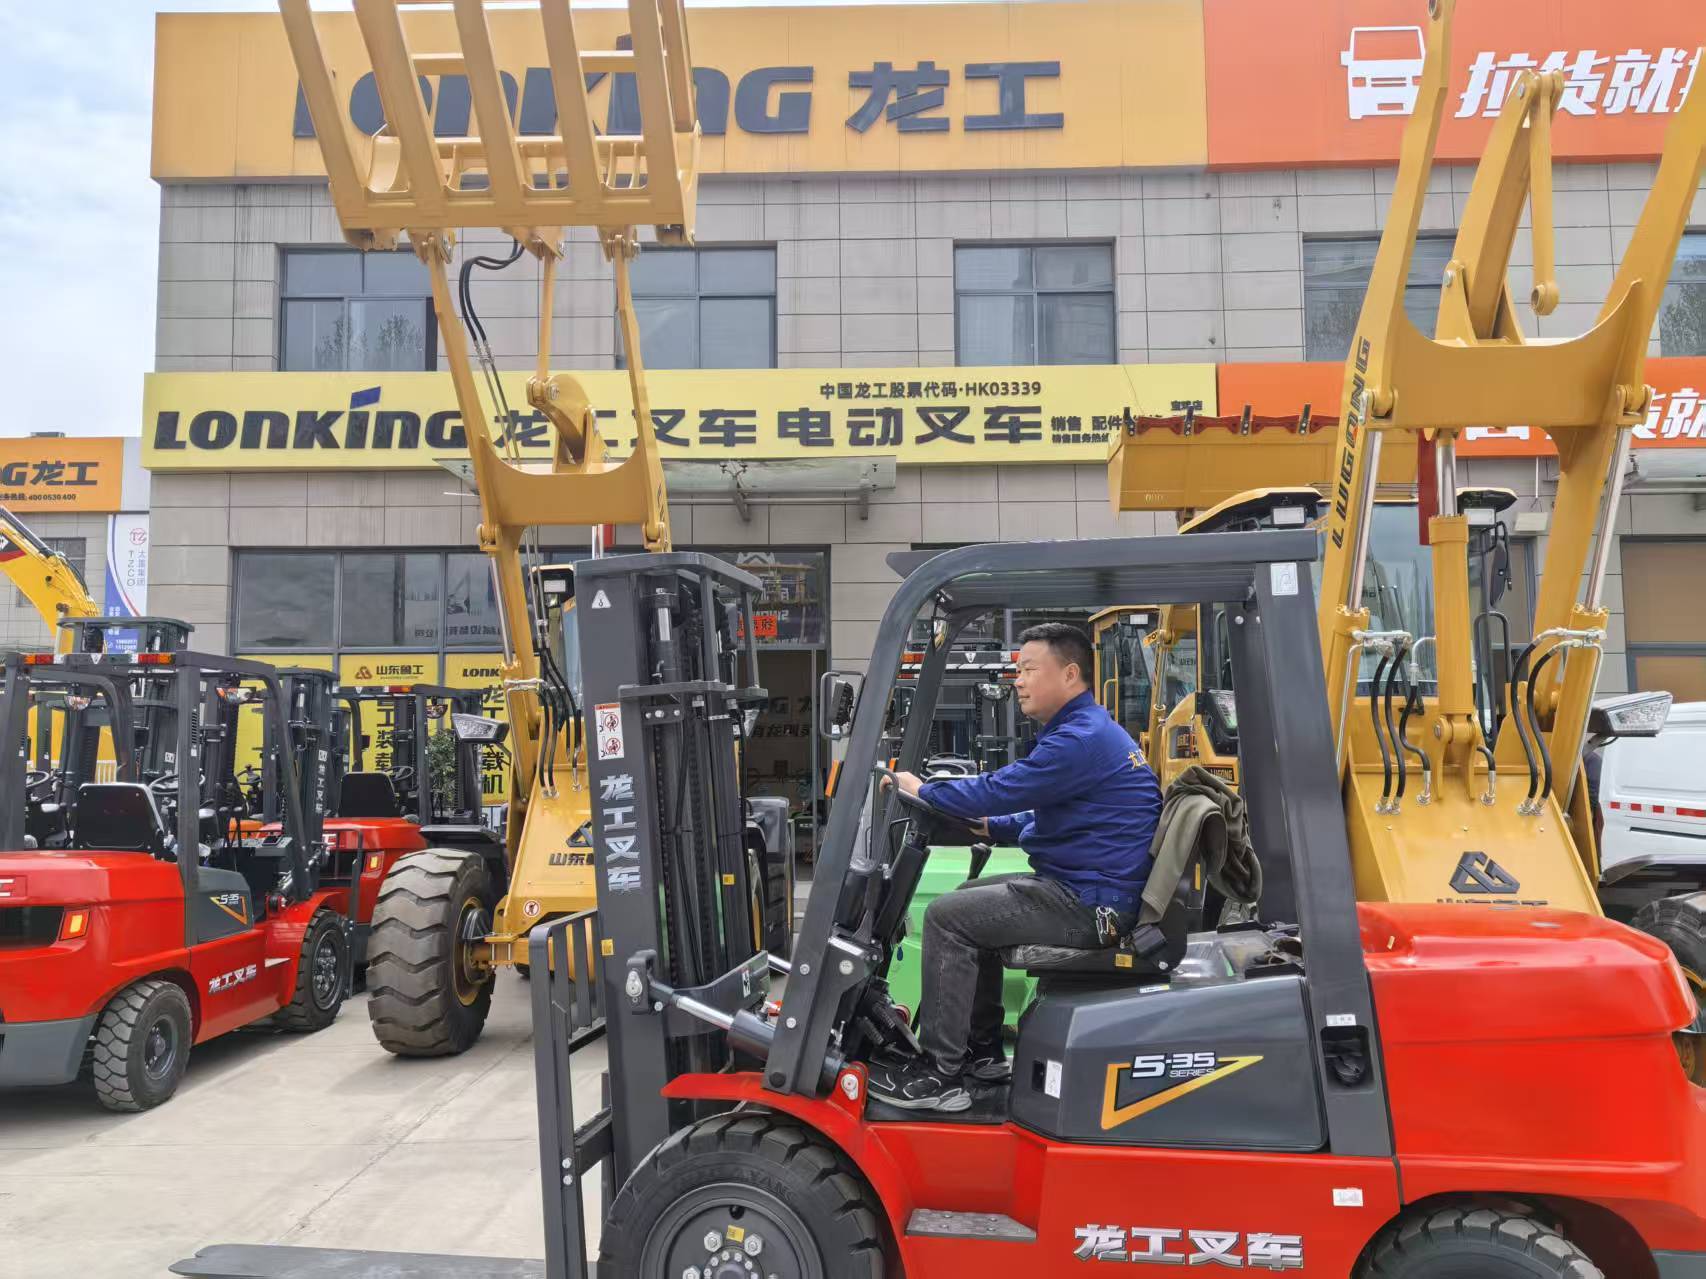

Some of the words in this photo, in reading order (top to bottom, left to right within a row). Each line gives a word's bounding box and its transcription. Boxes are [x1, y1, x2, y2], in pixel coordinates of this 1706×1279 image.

[293, 34, 814, 139] ONKIG
[845, 60, 1065, 134] 龙工
[154, 385, 468, 450] LONKING
[30, 460, 99, 486] 龙工
[599, 773, 642, 894] 龙工叉车
[207, 964, 257, 994] 龙工叉车
[1169, 1068, 1217, 1079] SERIES
[1073, 1223, 1304, 1271] 龙工叉车
